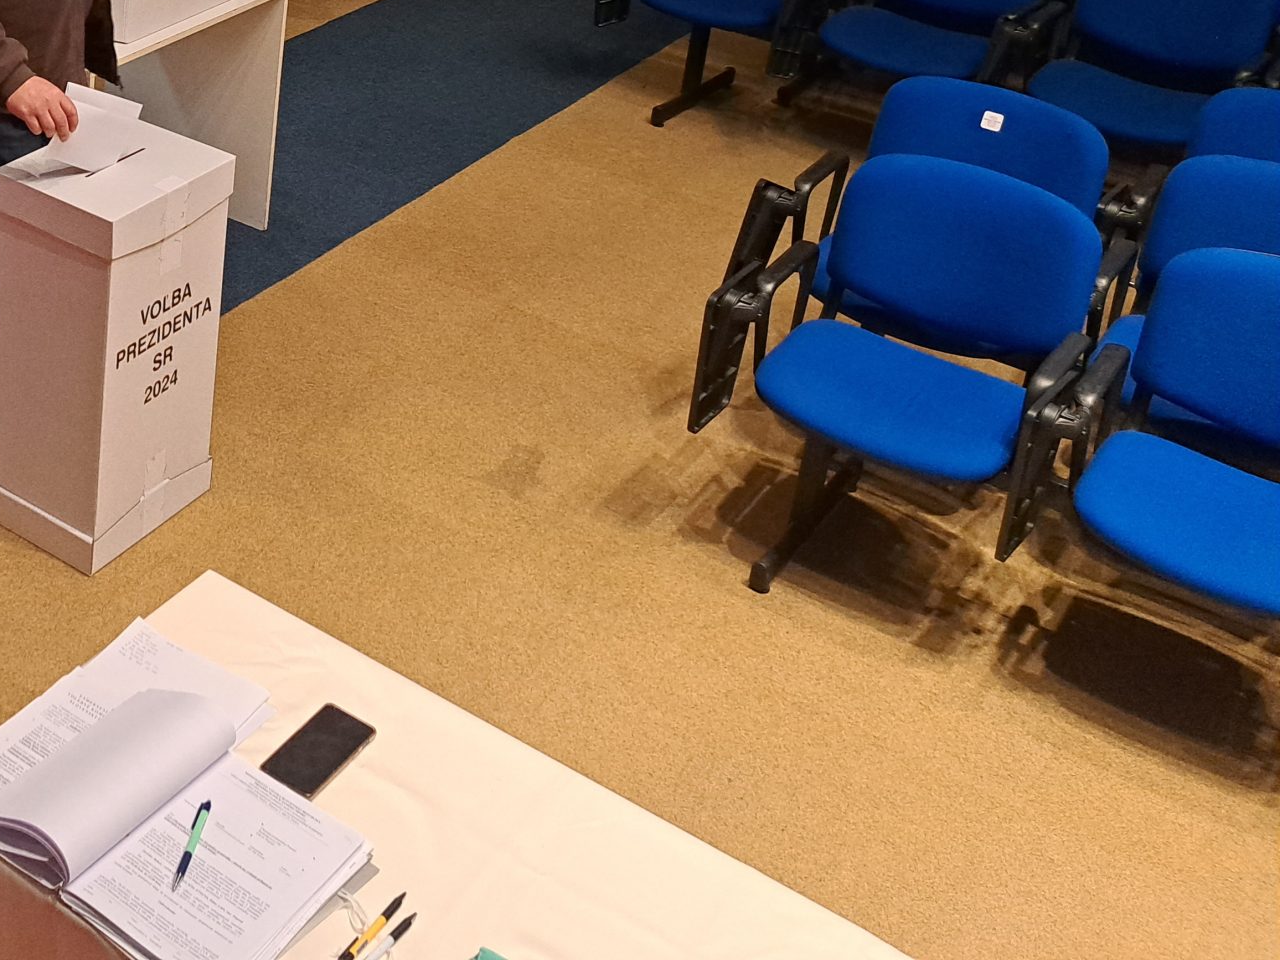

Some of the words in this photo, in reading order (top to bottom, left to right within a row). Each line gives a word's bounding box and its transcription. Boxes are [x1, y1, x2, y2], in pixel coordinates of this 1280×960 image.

[140, 282, 192, 325] VOĽBA
[115, 296, 212, 370] PREZIDENTA
[152, 345, 174, 371] SR
[143, 369, 178, 405] 2024
